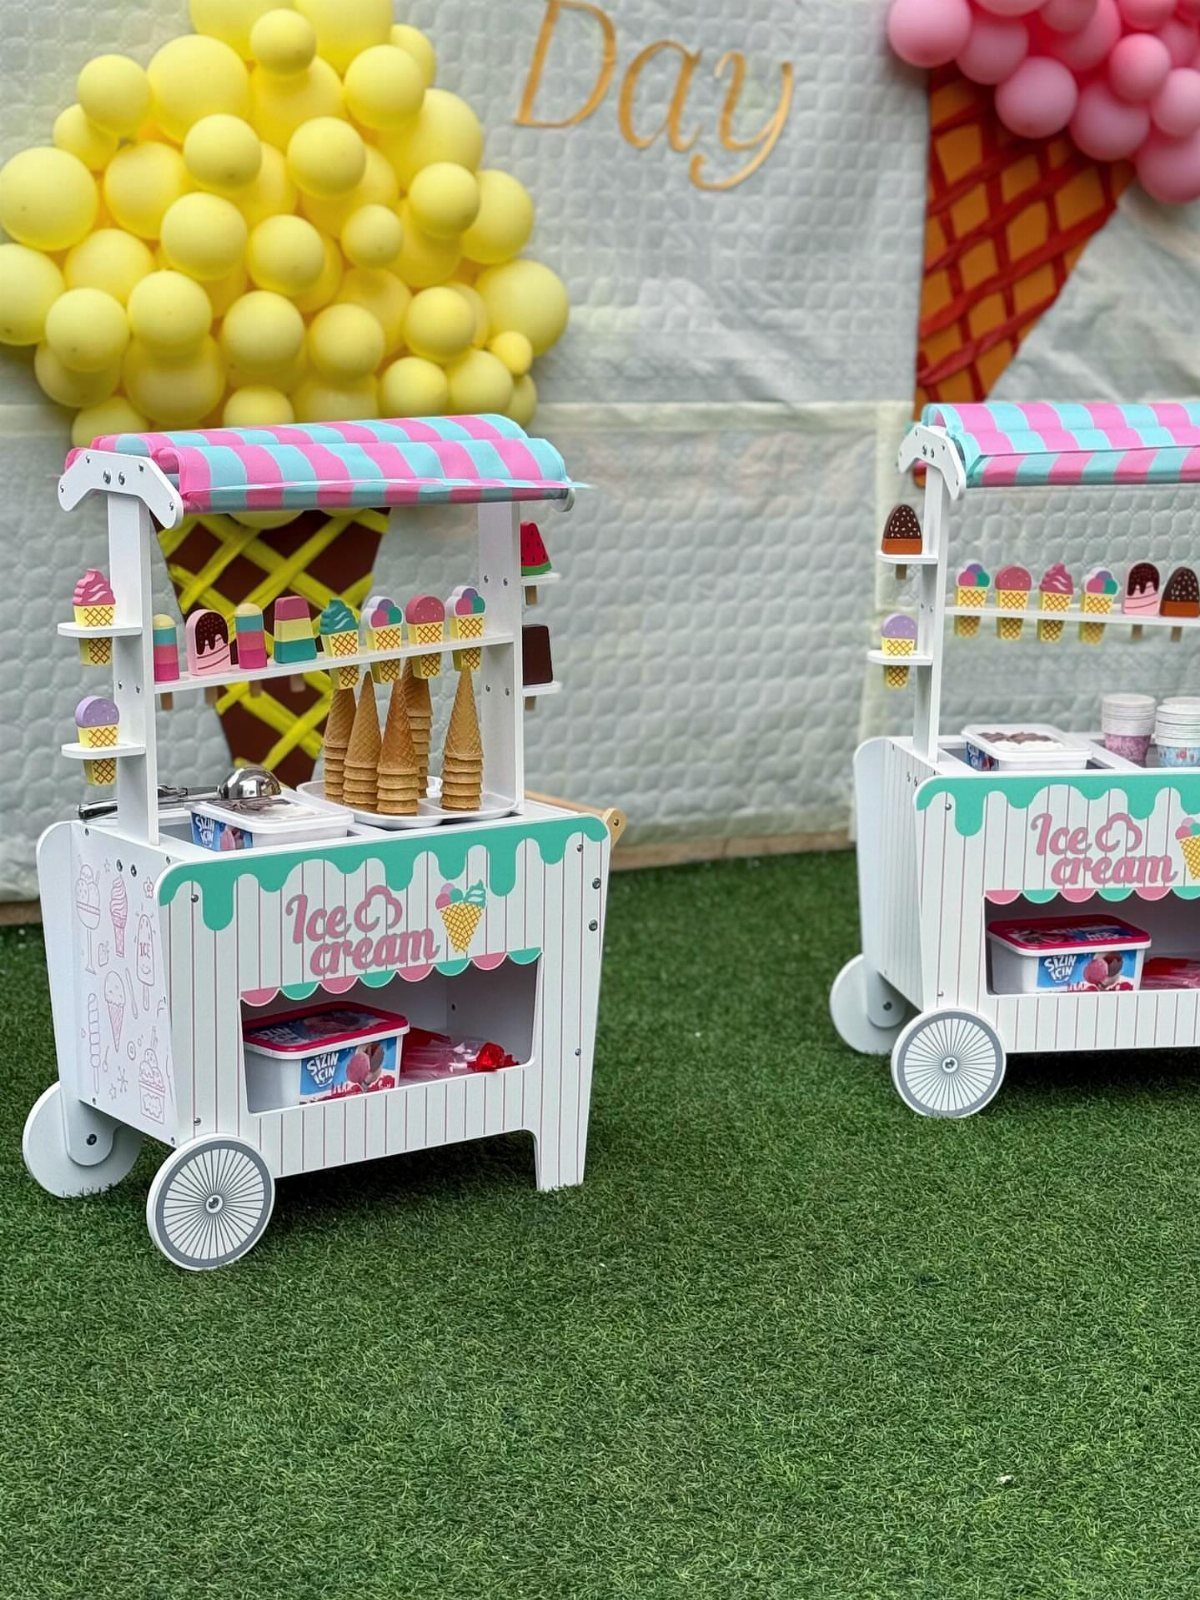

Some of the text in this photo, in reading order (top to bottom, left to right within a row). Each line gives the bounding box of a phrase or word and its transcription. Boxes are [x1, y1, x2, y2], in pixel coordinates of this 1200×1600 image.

[513, 0, 794, 192] Day
[1030, 812, 1093, 856] Ice
[1051, 855, 1179, 885] cream
[285, 893, 353, 945] Ice
[309, 928, 441, 976] cream
